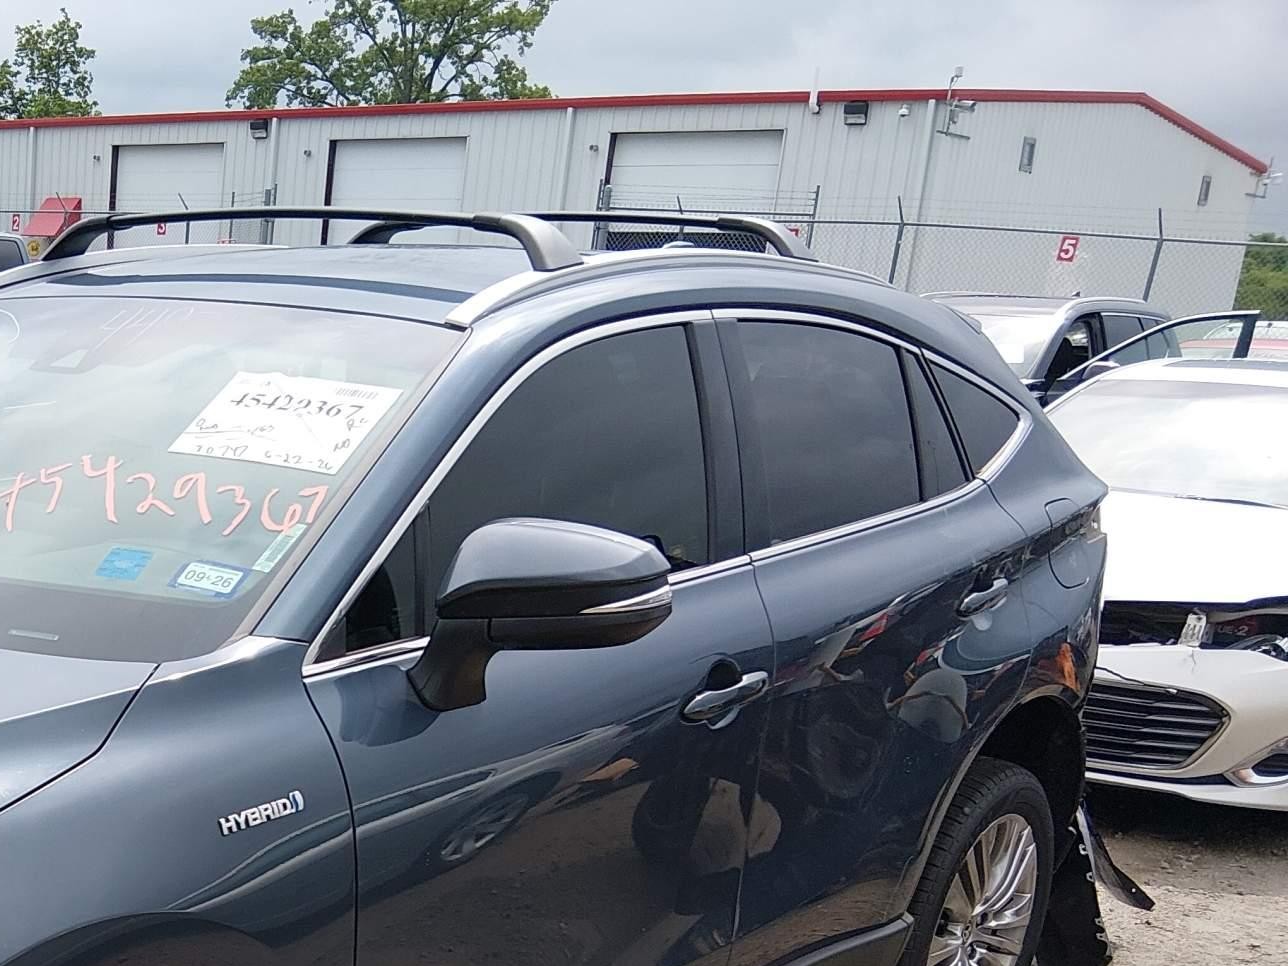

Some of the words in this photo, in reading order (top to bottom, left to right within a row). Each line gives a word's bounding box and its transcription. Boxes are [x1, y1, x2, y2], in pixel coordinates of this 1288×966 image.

[1059, 239, 1077, 259] 5
[229, 391, 366, 419] 45429367
[217, 797, 296, 836] HYBRID
